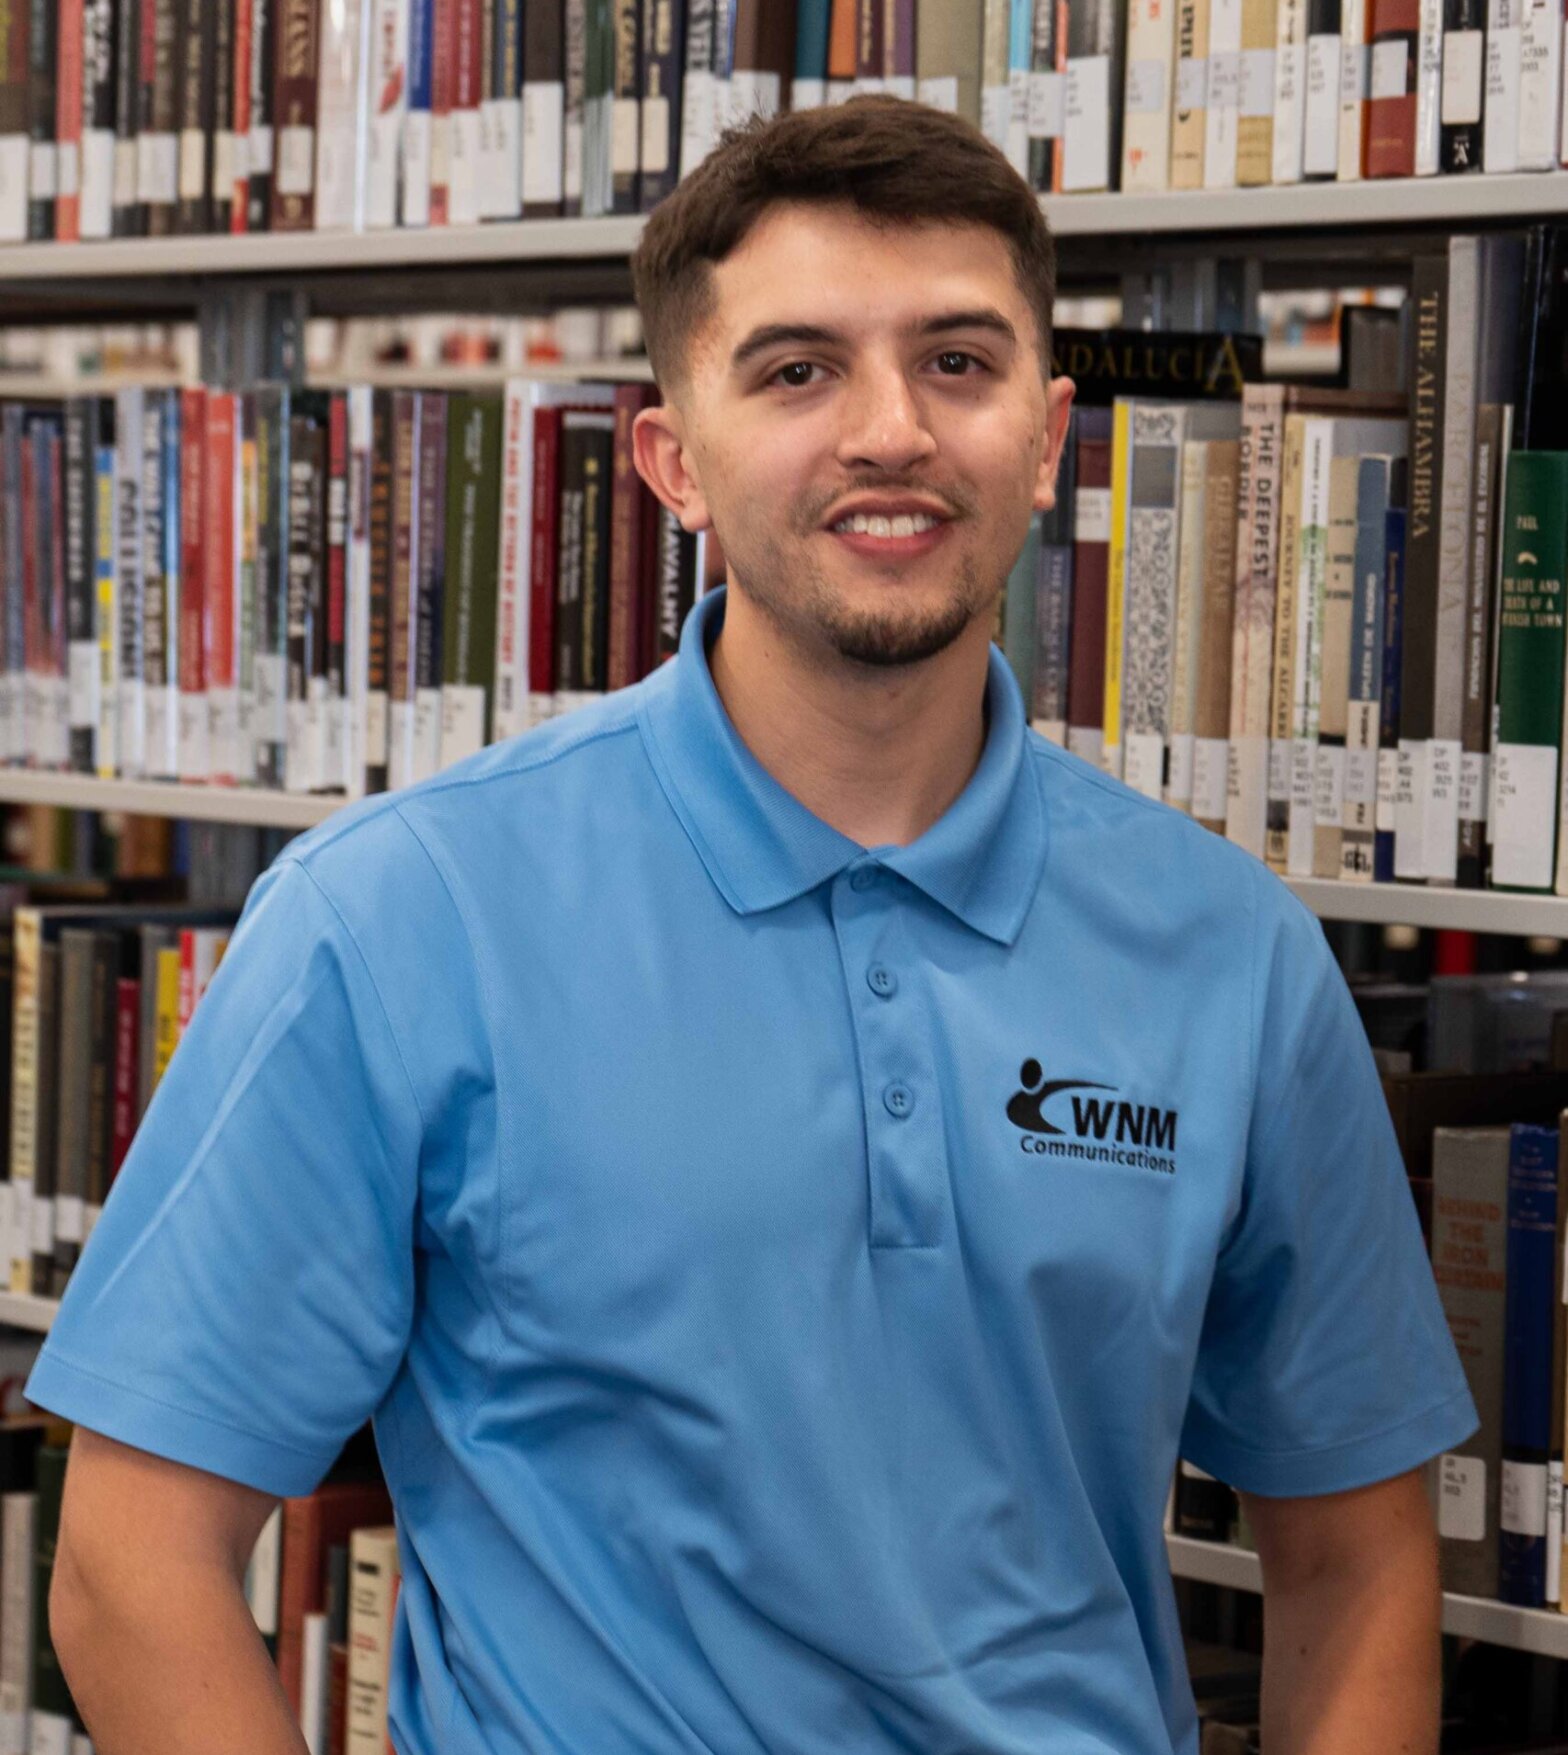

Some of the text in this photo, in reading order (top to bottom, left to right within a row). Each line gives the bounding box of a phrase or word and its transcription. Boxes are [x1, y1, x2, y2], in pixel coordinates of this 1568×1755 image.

[1412, 290, 1439, 539] THE ALHAMBRA
[1237, 424, 1253, 520] BORDER
[1252, 424, 1275, 578] THE DEEPEST
[1020, 1135, 1176, 1174] Communications
[1071, 1096, 1178, 1152] WNM
